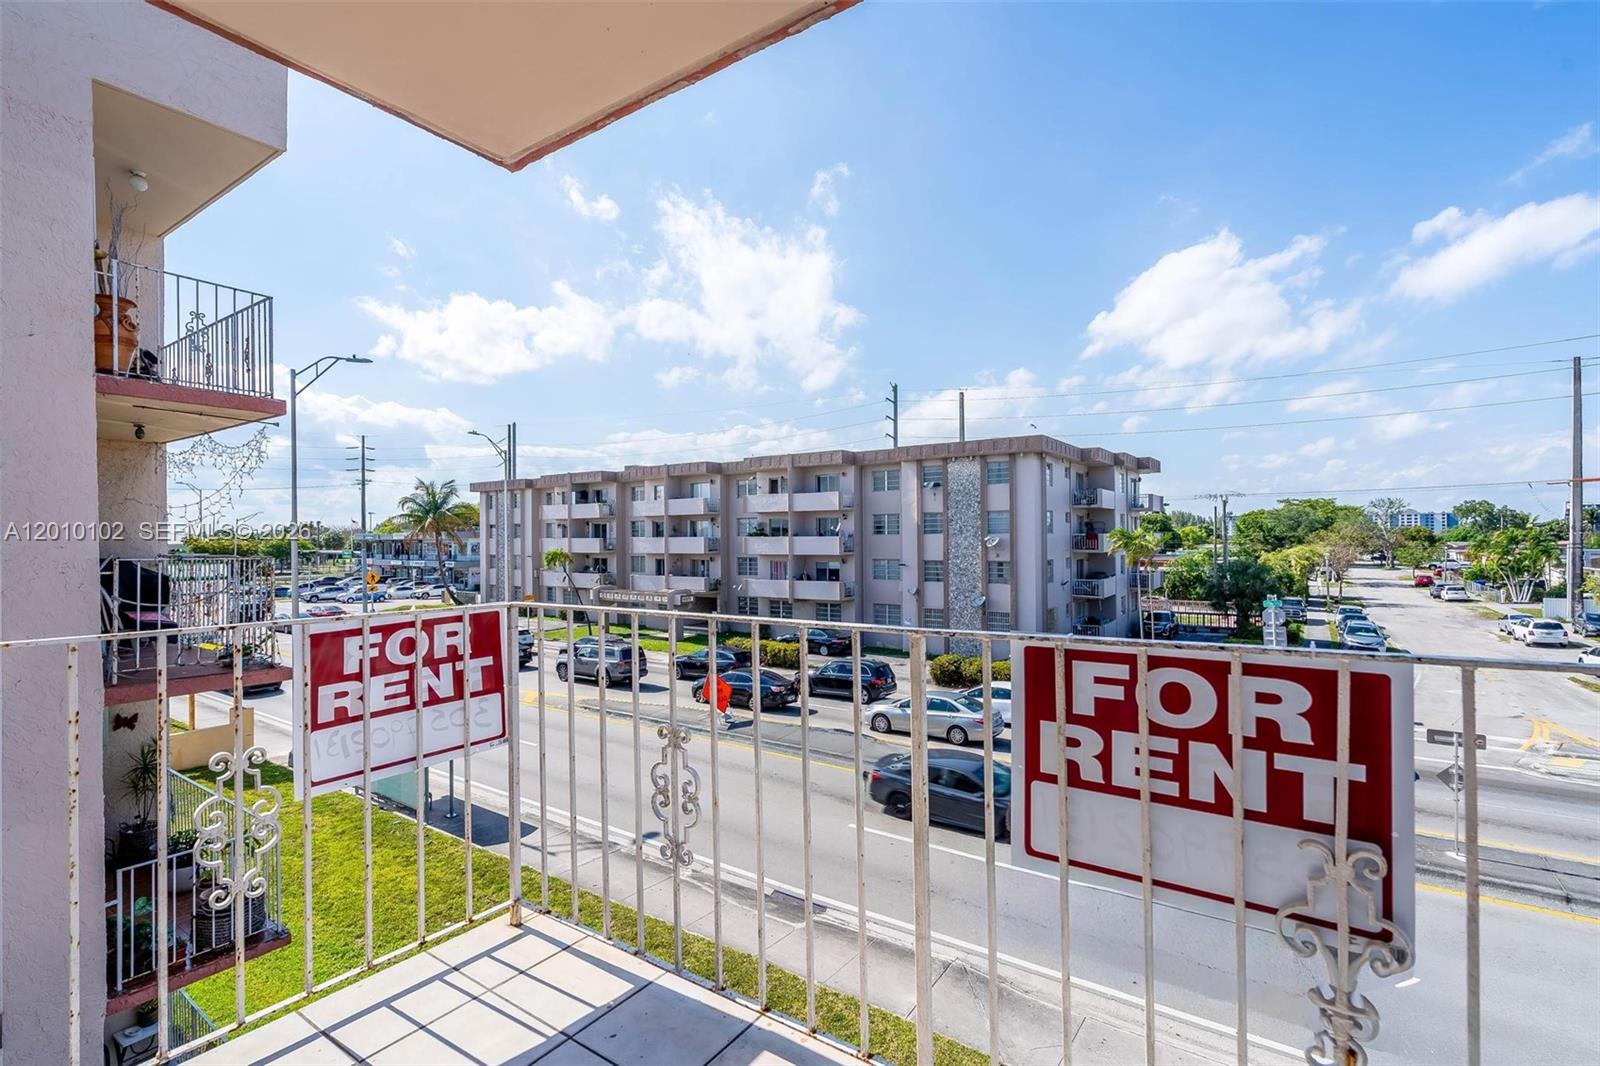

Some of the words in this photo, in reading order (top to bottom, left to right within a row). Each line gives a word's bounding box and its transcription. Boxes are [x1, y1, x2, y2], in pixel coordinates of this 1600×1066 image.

[343, 622, 473, 675] FOR
[317, 656, 494, 725] RENT
[1071, 660, 1315, 746] FOR
[1039, 719, 1367, 825] RENT
